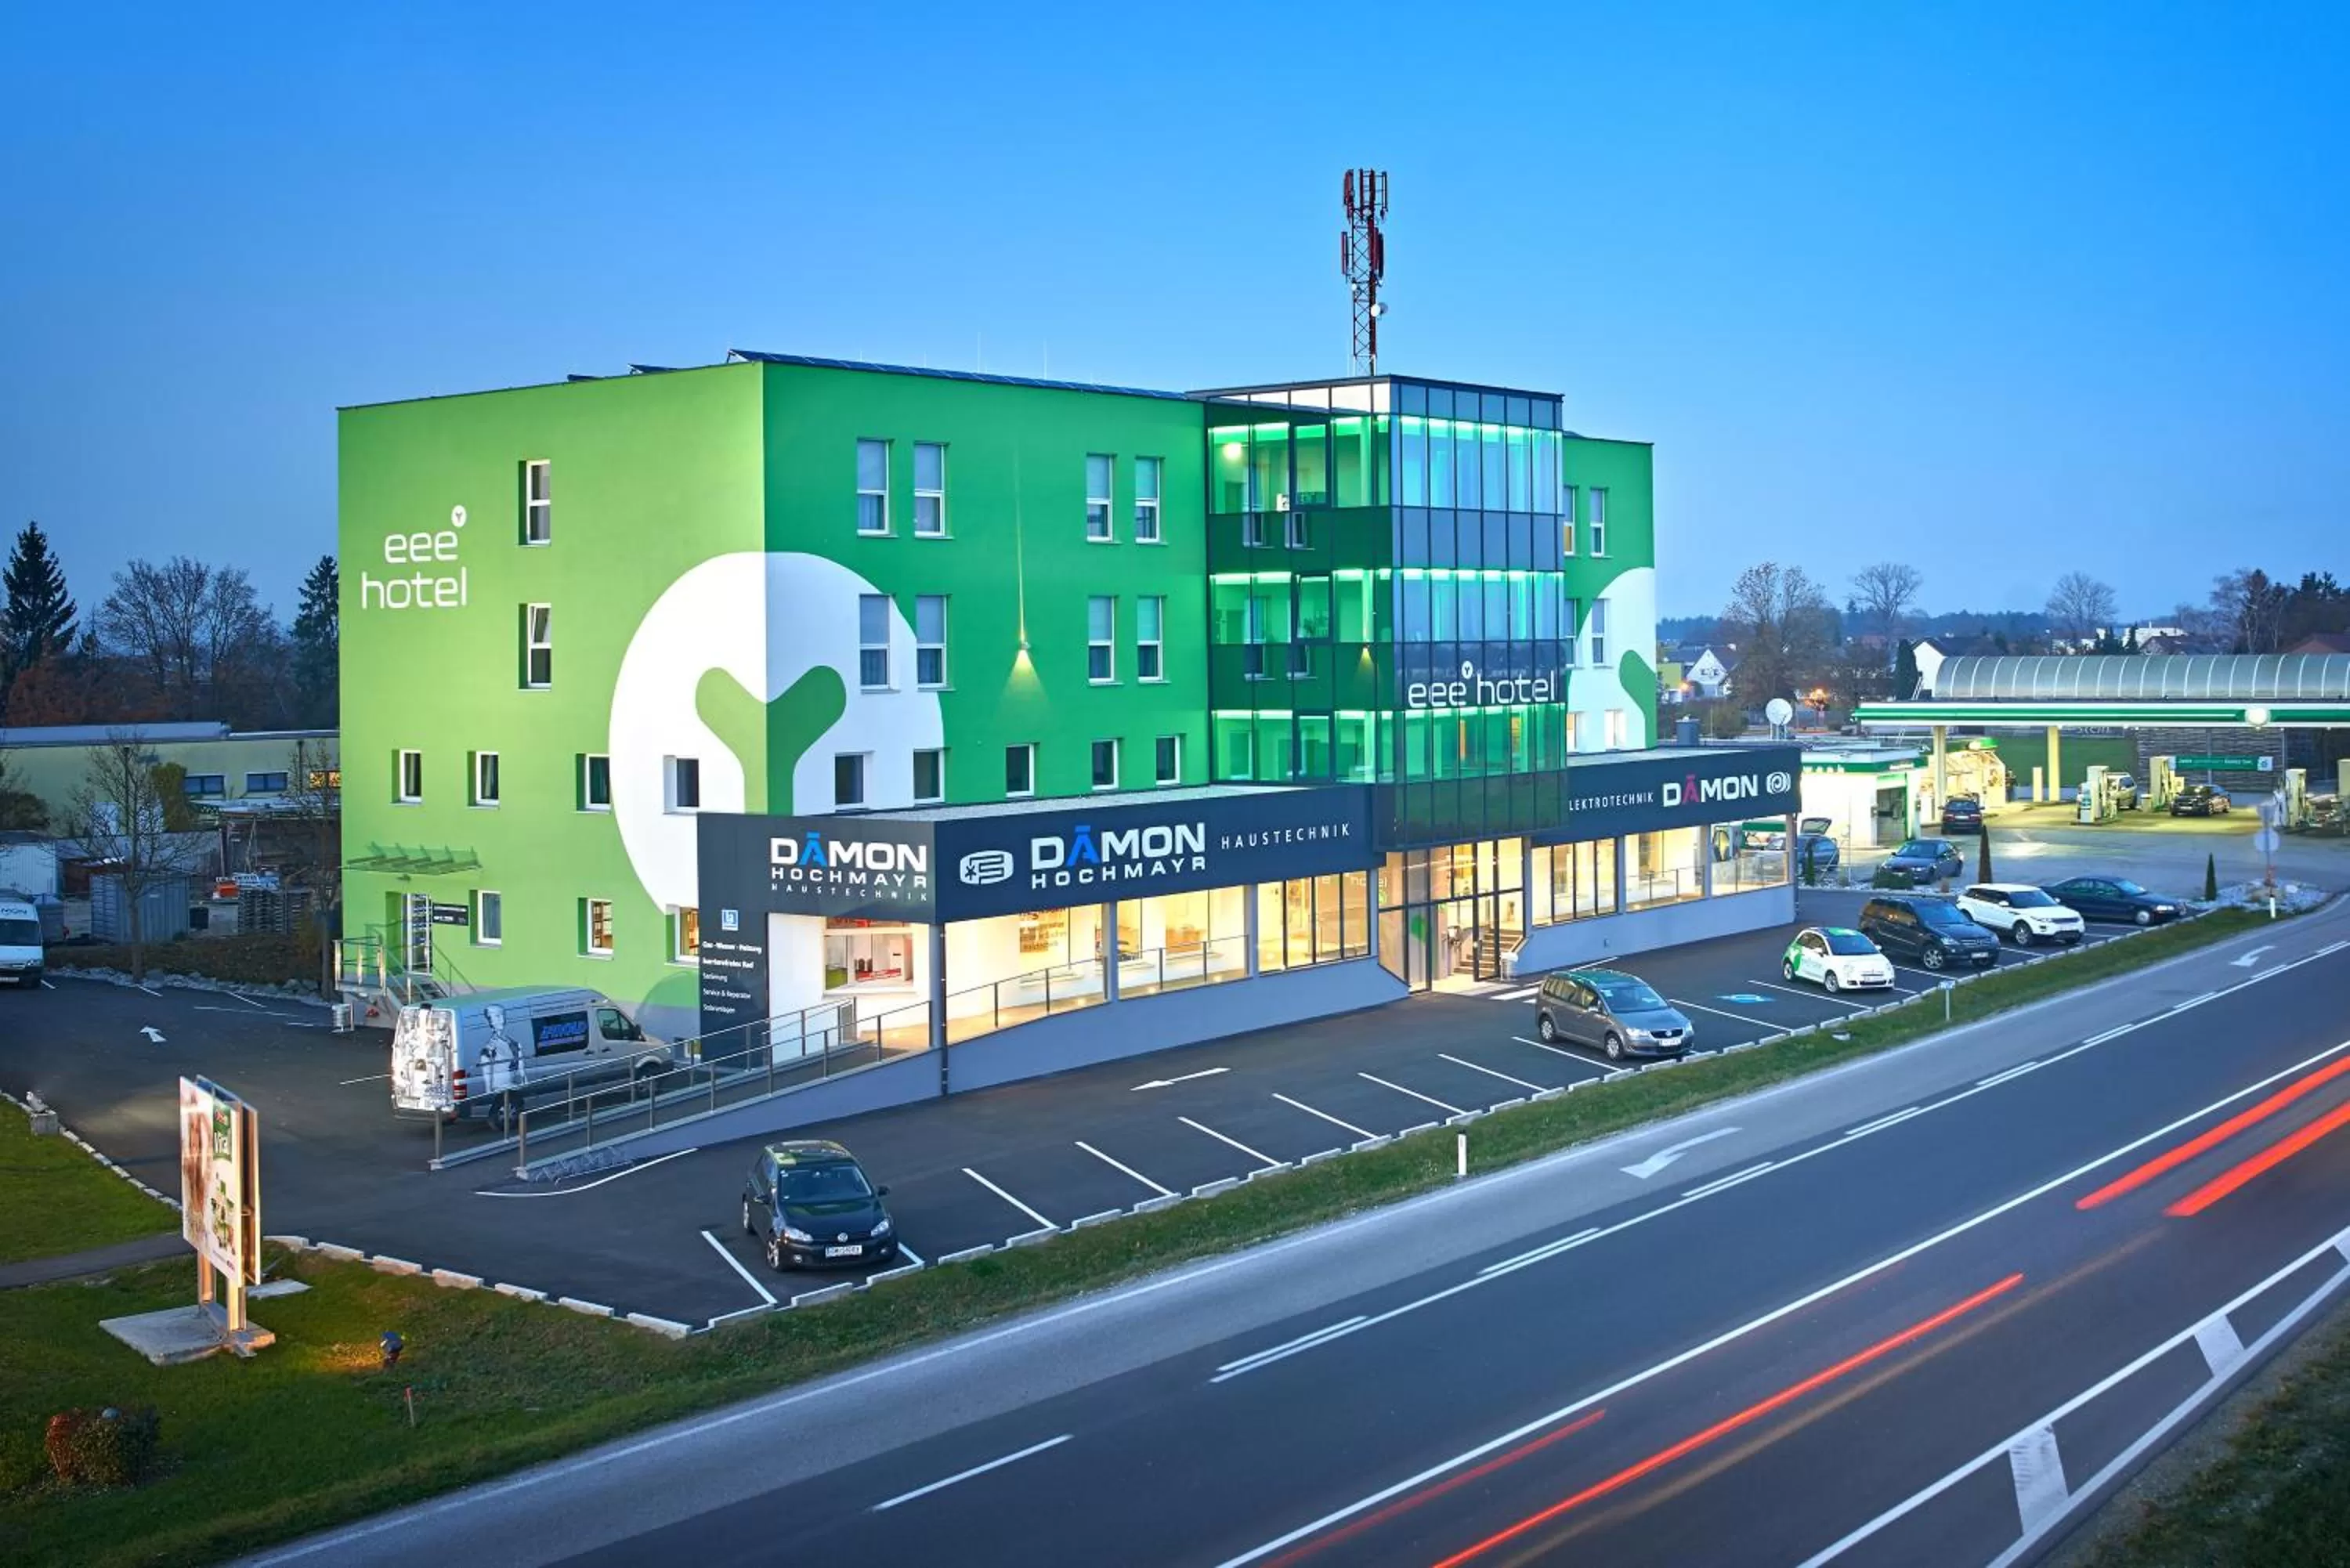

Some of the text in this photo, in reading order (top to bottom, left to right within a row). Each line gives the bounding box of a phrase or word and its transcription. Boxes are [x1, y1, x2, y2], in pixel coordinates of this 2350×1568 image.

[385, 531, 458, 563] eee
[361, 565, 467, 610] hotel
[1408, 670, 1555, 709] eee hotel
[1569, 792, 1654, 811] LEKTROTECHNIK
[1221, 822, 1350, 850] HAUSTECHNIK
[772, 867, 927, 888] HOCHMAYR
[1032, 856, 1206, 890] HOCHMAYR
[772, 883, 927, 901] HAUSTECHNIK
